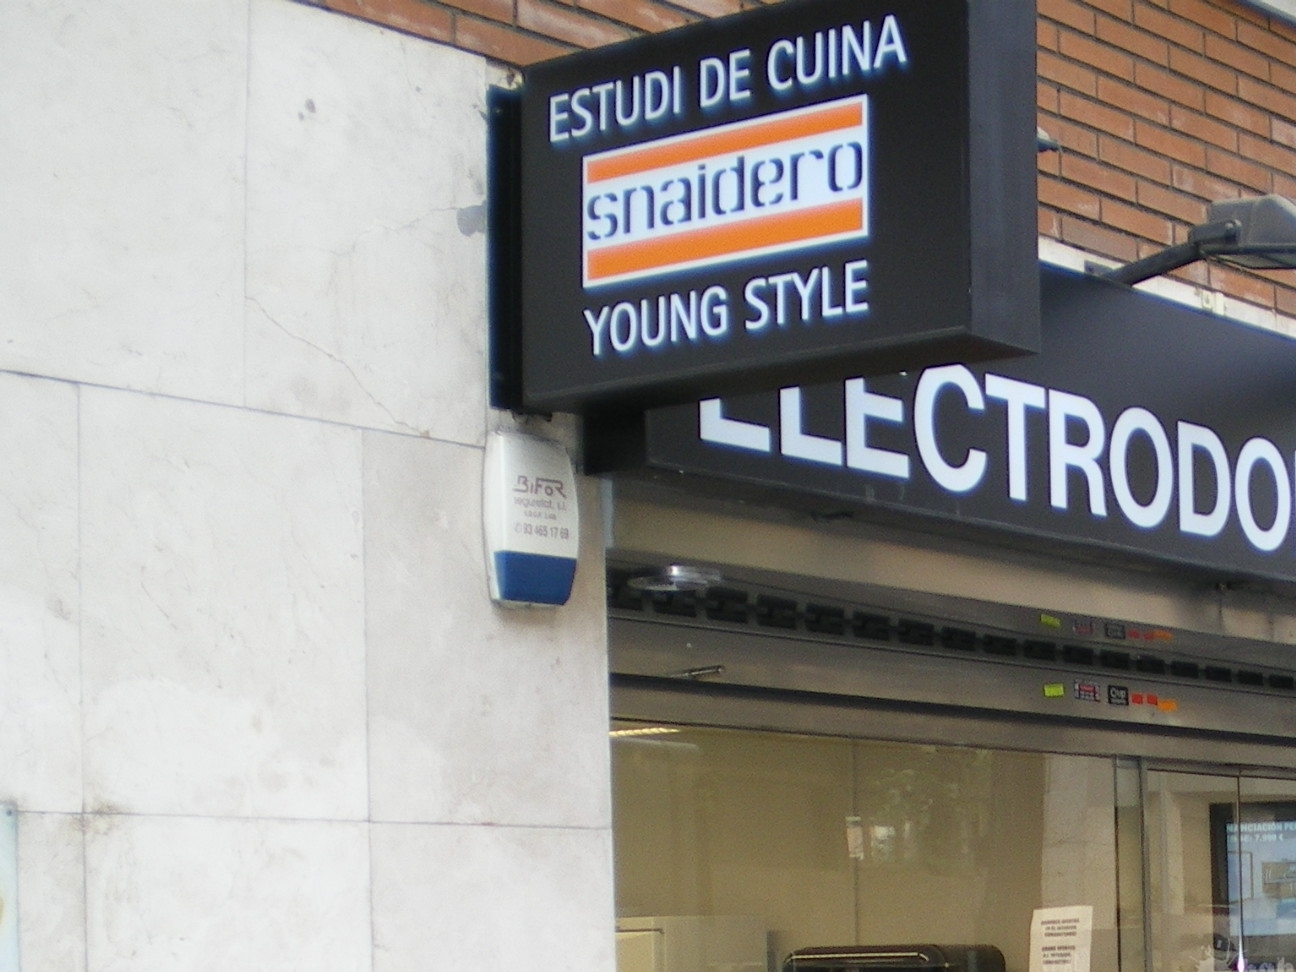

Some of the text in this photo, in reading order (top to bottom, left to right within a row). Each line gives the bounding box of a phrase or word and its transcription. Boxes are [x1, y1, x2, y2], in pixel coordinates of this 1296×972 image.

[549, 14, 907, 143] ESTUDI DE CUINA
[587, 140, 863, 241] snaidero
[584, 260, 868, 357] YOUNG STYLE
